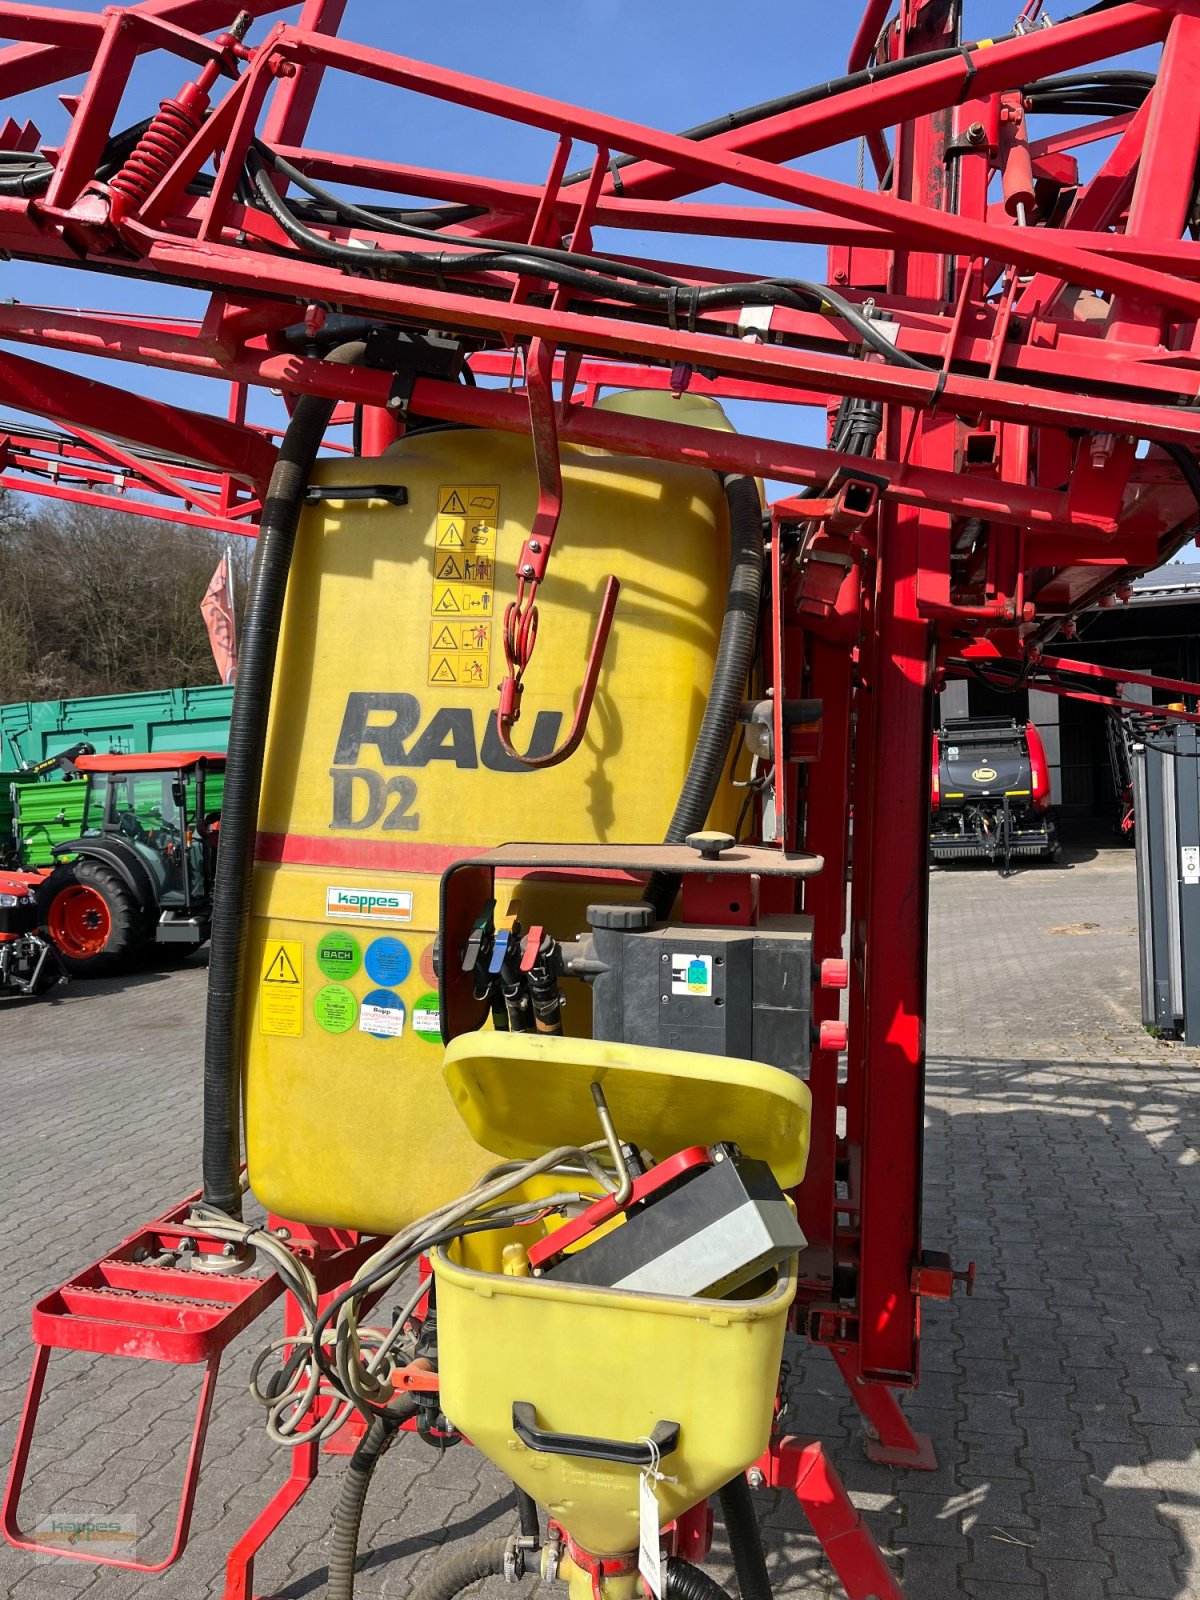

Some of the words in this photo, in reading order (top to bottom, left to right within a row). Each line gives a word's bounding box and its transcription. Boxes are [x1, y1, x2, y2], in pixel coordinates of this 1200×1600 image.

[333, 692, 563, 772] RAU
[328, 768, 420, 831] D2
[337, 892, 399, 914] kappes
[323, 951, 351, 959] BACH
